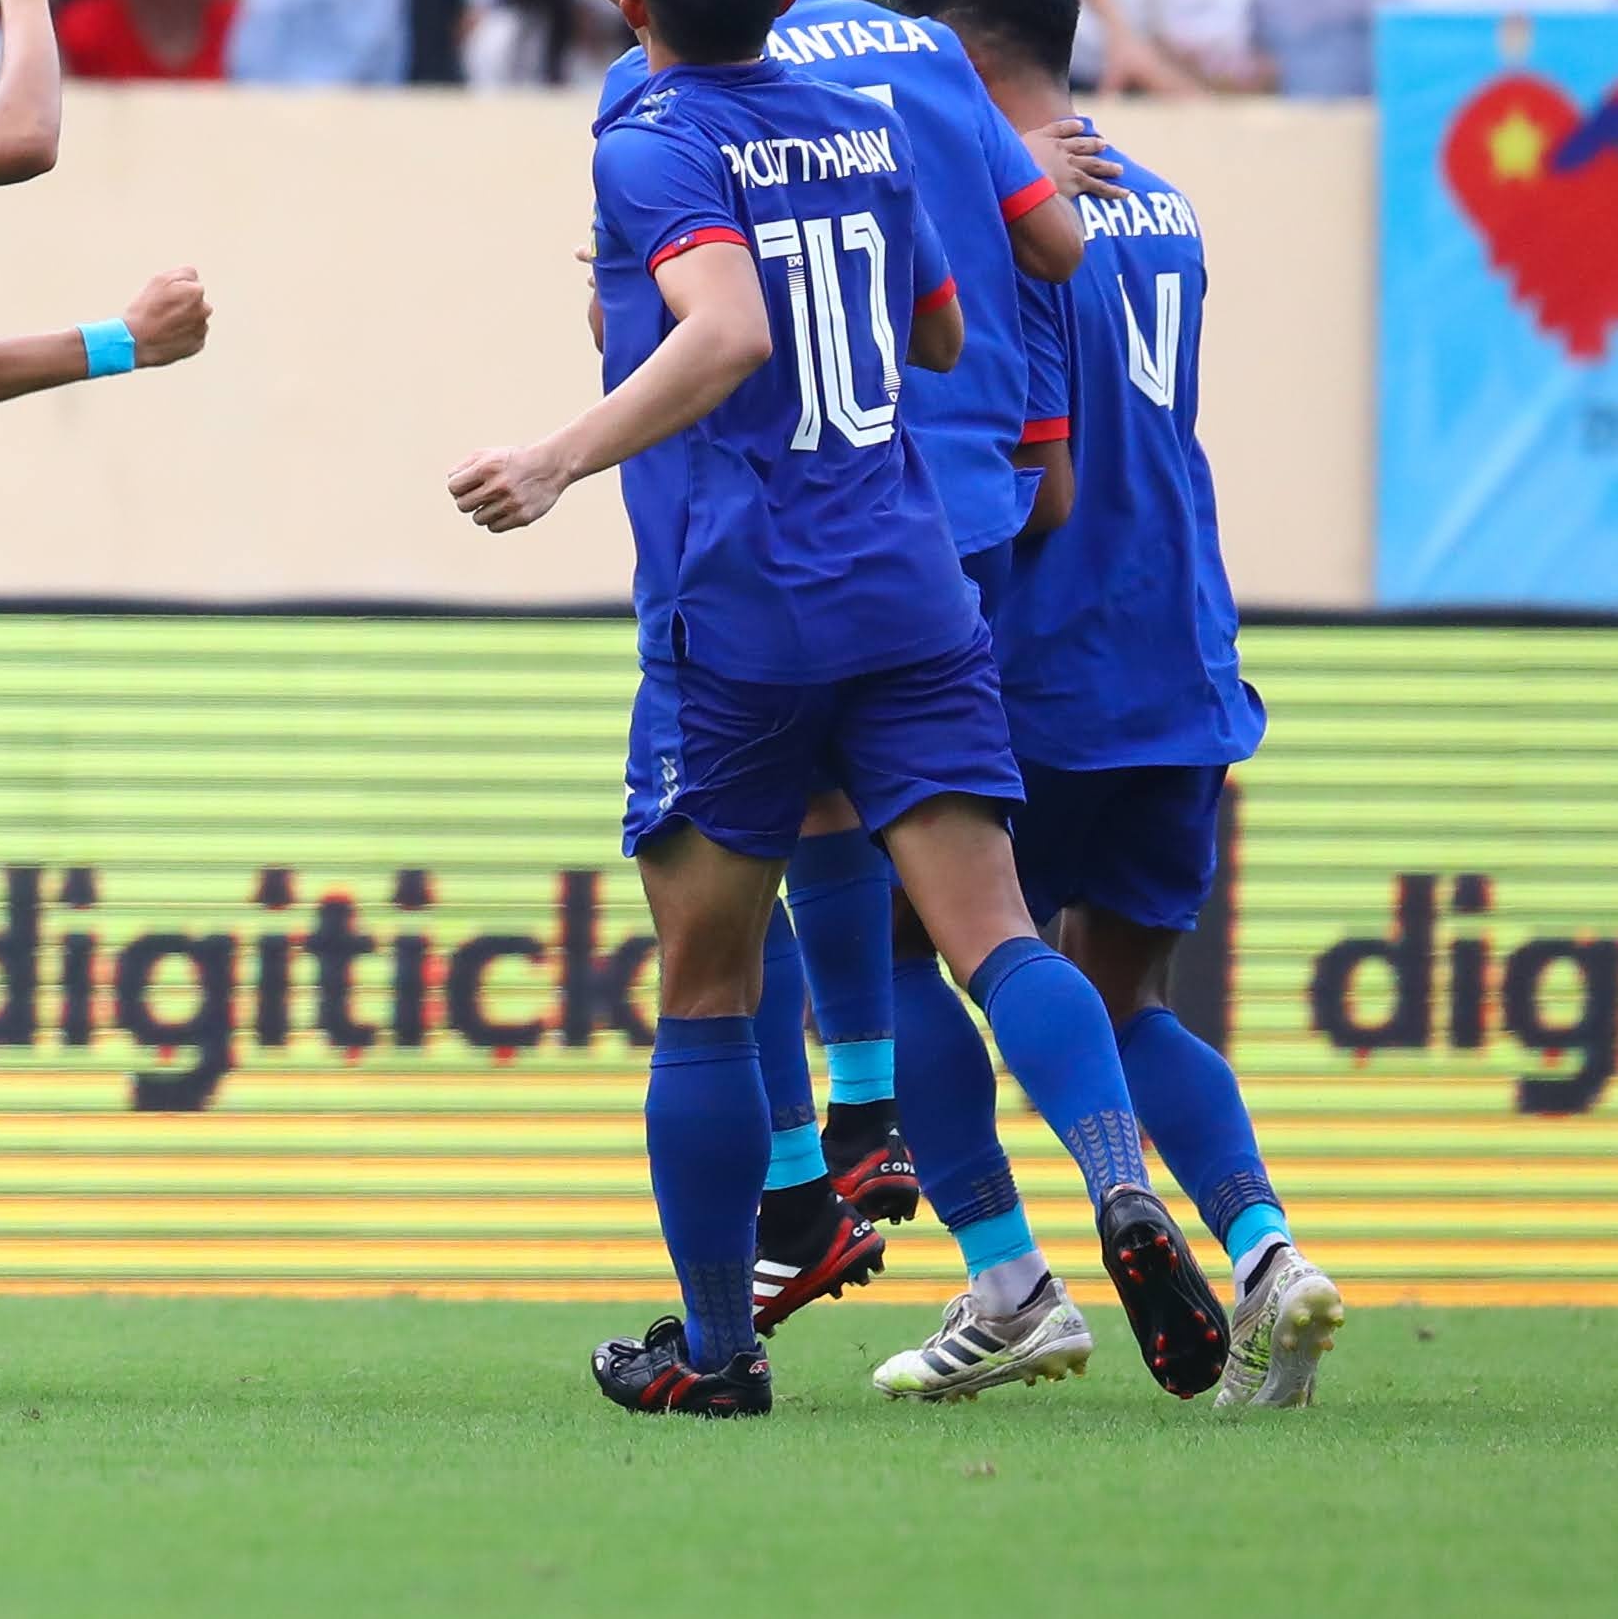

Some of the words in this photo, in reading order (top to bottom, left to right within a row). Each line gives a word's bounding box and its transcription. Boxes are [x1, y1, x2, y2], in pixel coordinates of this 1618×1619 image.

[759, 19, 939, 66] ANTAZA
[1078, 191, 1198, 242] AHARN
[753, 211, 897, 452] 10
